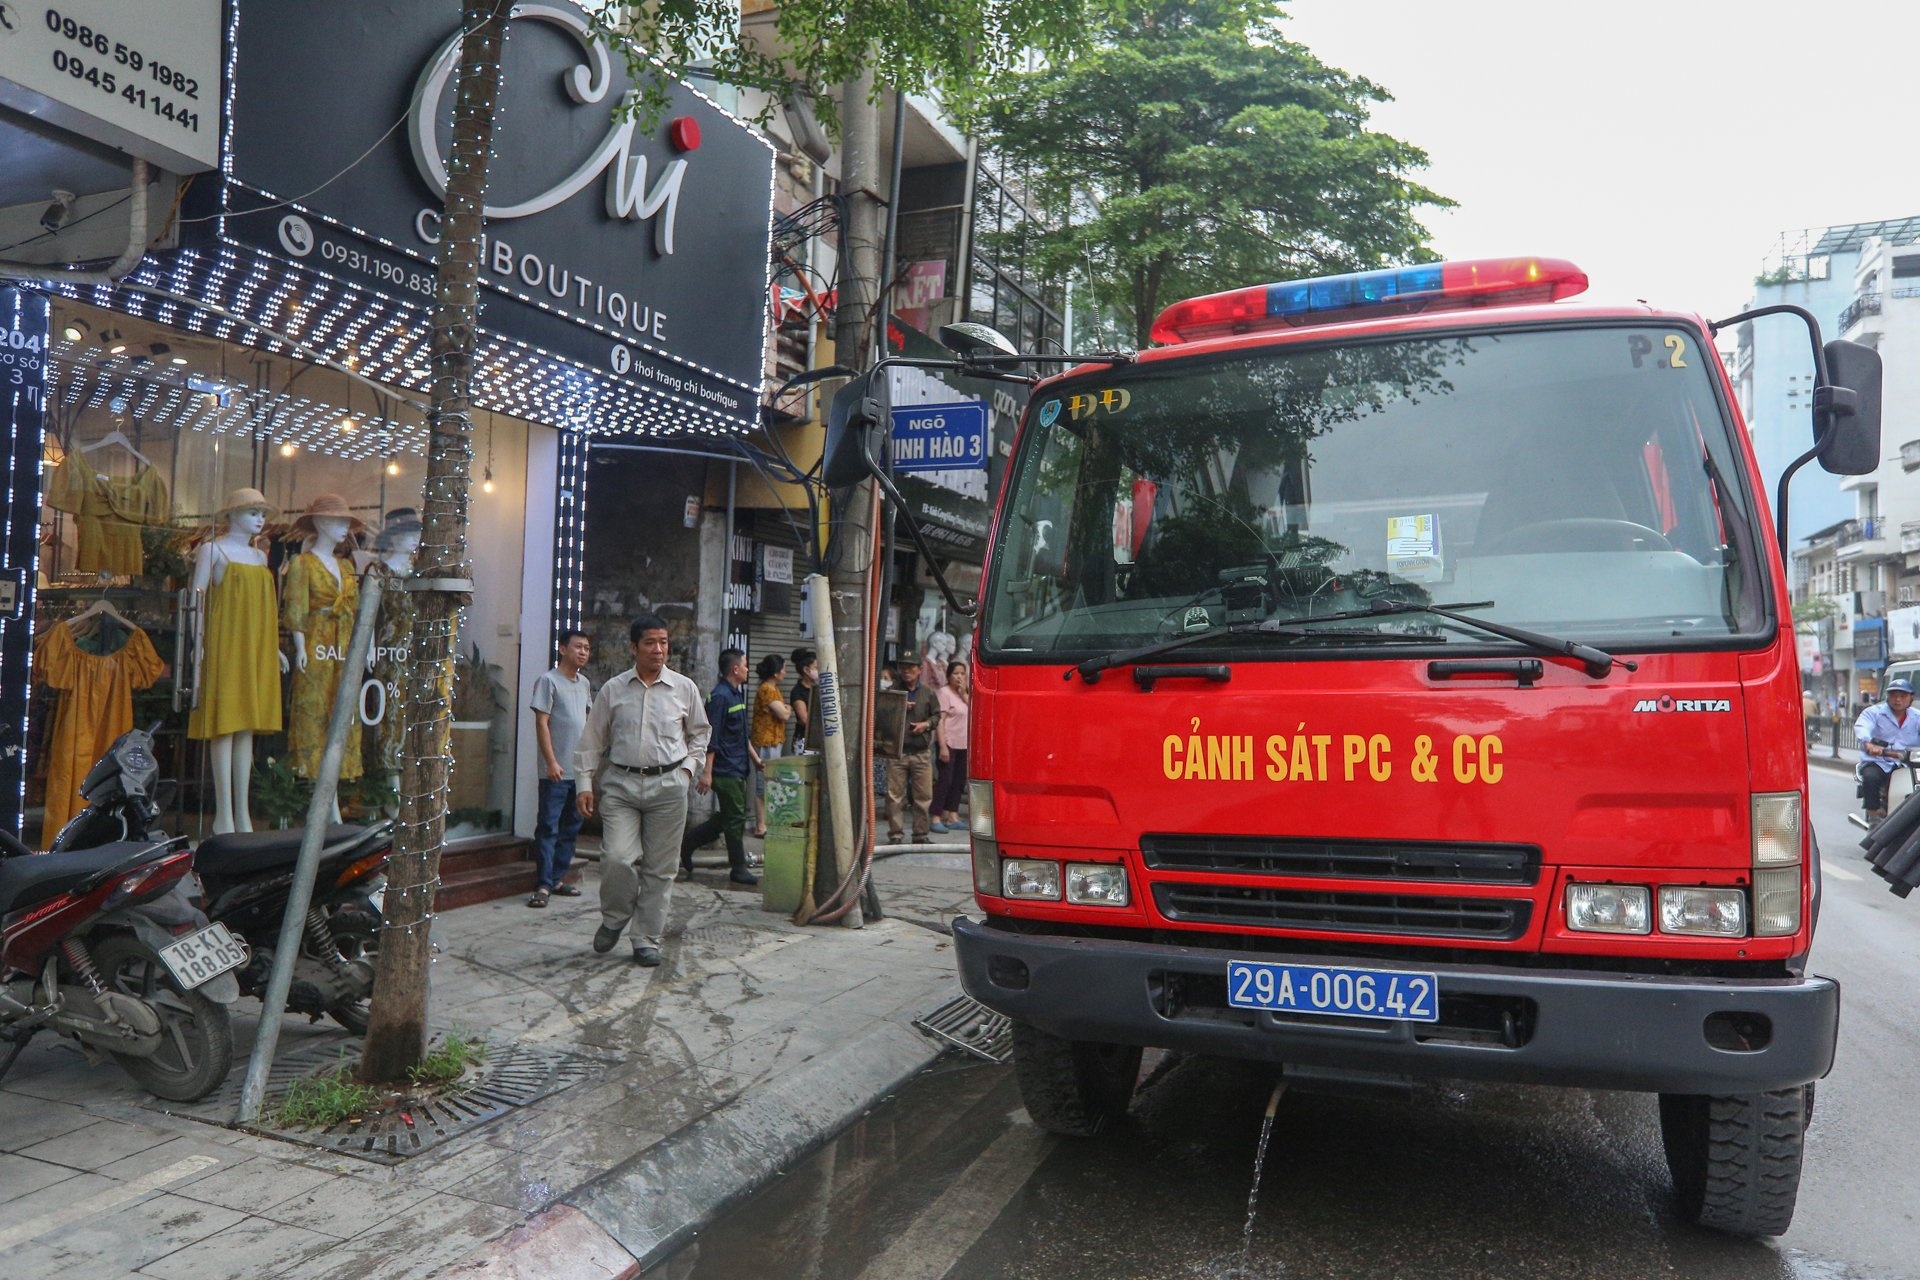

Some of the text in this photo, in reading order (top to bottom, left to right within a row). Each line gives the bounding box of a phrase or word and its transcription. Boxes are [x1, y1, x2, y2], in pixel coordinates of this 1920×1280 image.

[46, 9, 199, 101] 0986 59 1982
[53, 50, 199, 133] 0945 41 1441
[415, 208, 668, 343] CIBOUTIQUE
[10, 369, 23, 385] 3
[19, 356, 40, 371] sở
[634, 360, 654, 379] thoi
[656, 368, 681, 392] trang
[683, 379, 698, 395] chi
[700, 384, 738, 409] boutique
[909, 414, 946, 431] NGÕ
[892, 437, 925, 465] ỊNH
[929, 431, 965, 459] HÀO
[969, 434, 981, 457] 3
[315, 645, 346, 661] SAL
[1633, 694, 1731, 713] MORITA
[1162, 716, 1504, 784] CẢNH SÁT PC & CC
[172, 929, 223, 963] 18-K1
[179, 942, 241, 984] 188.05
[1234, 966, 1431, 1017] 29A-006.42
